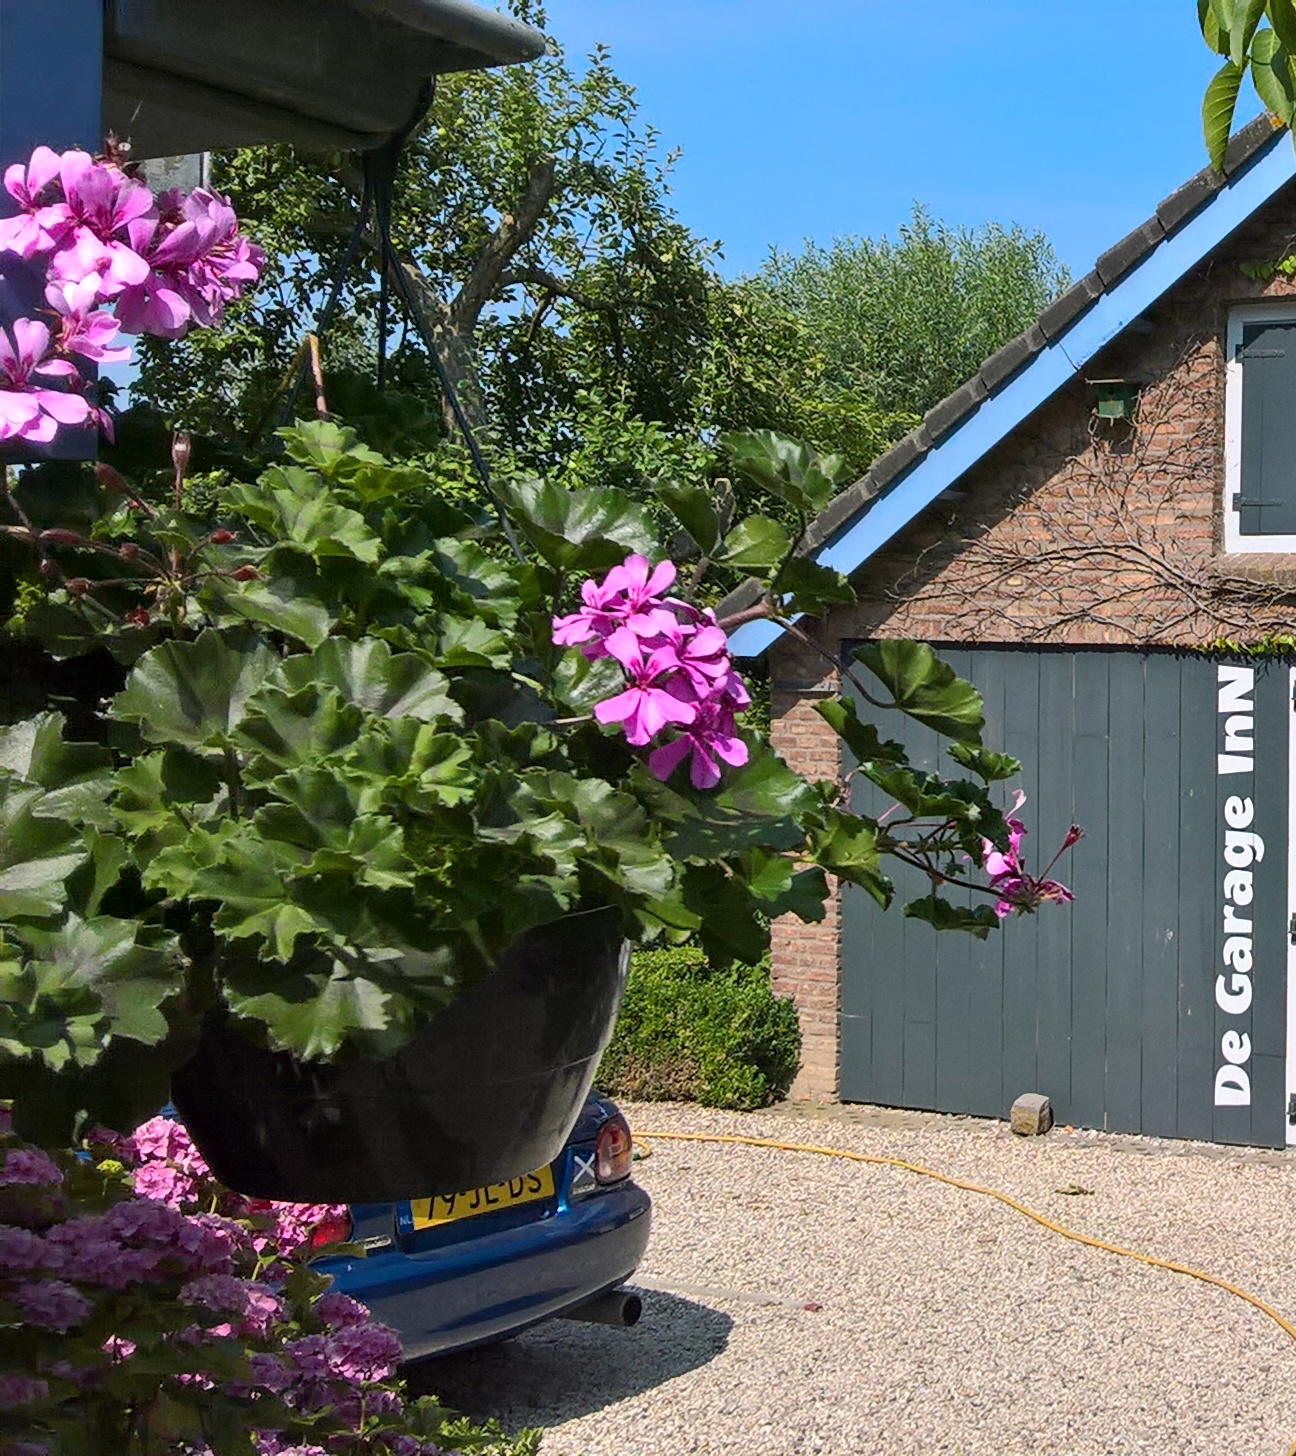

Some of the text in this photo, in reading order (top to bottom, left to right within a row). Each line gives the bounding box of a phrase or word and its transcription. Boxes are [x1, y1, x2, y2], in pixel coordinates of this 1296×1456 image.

[1214, 664, 1265, 1106] De Garage InN
